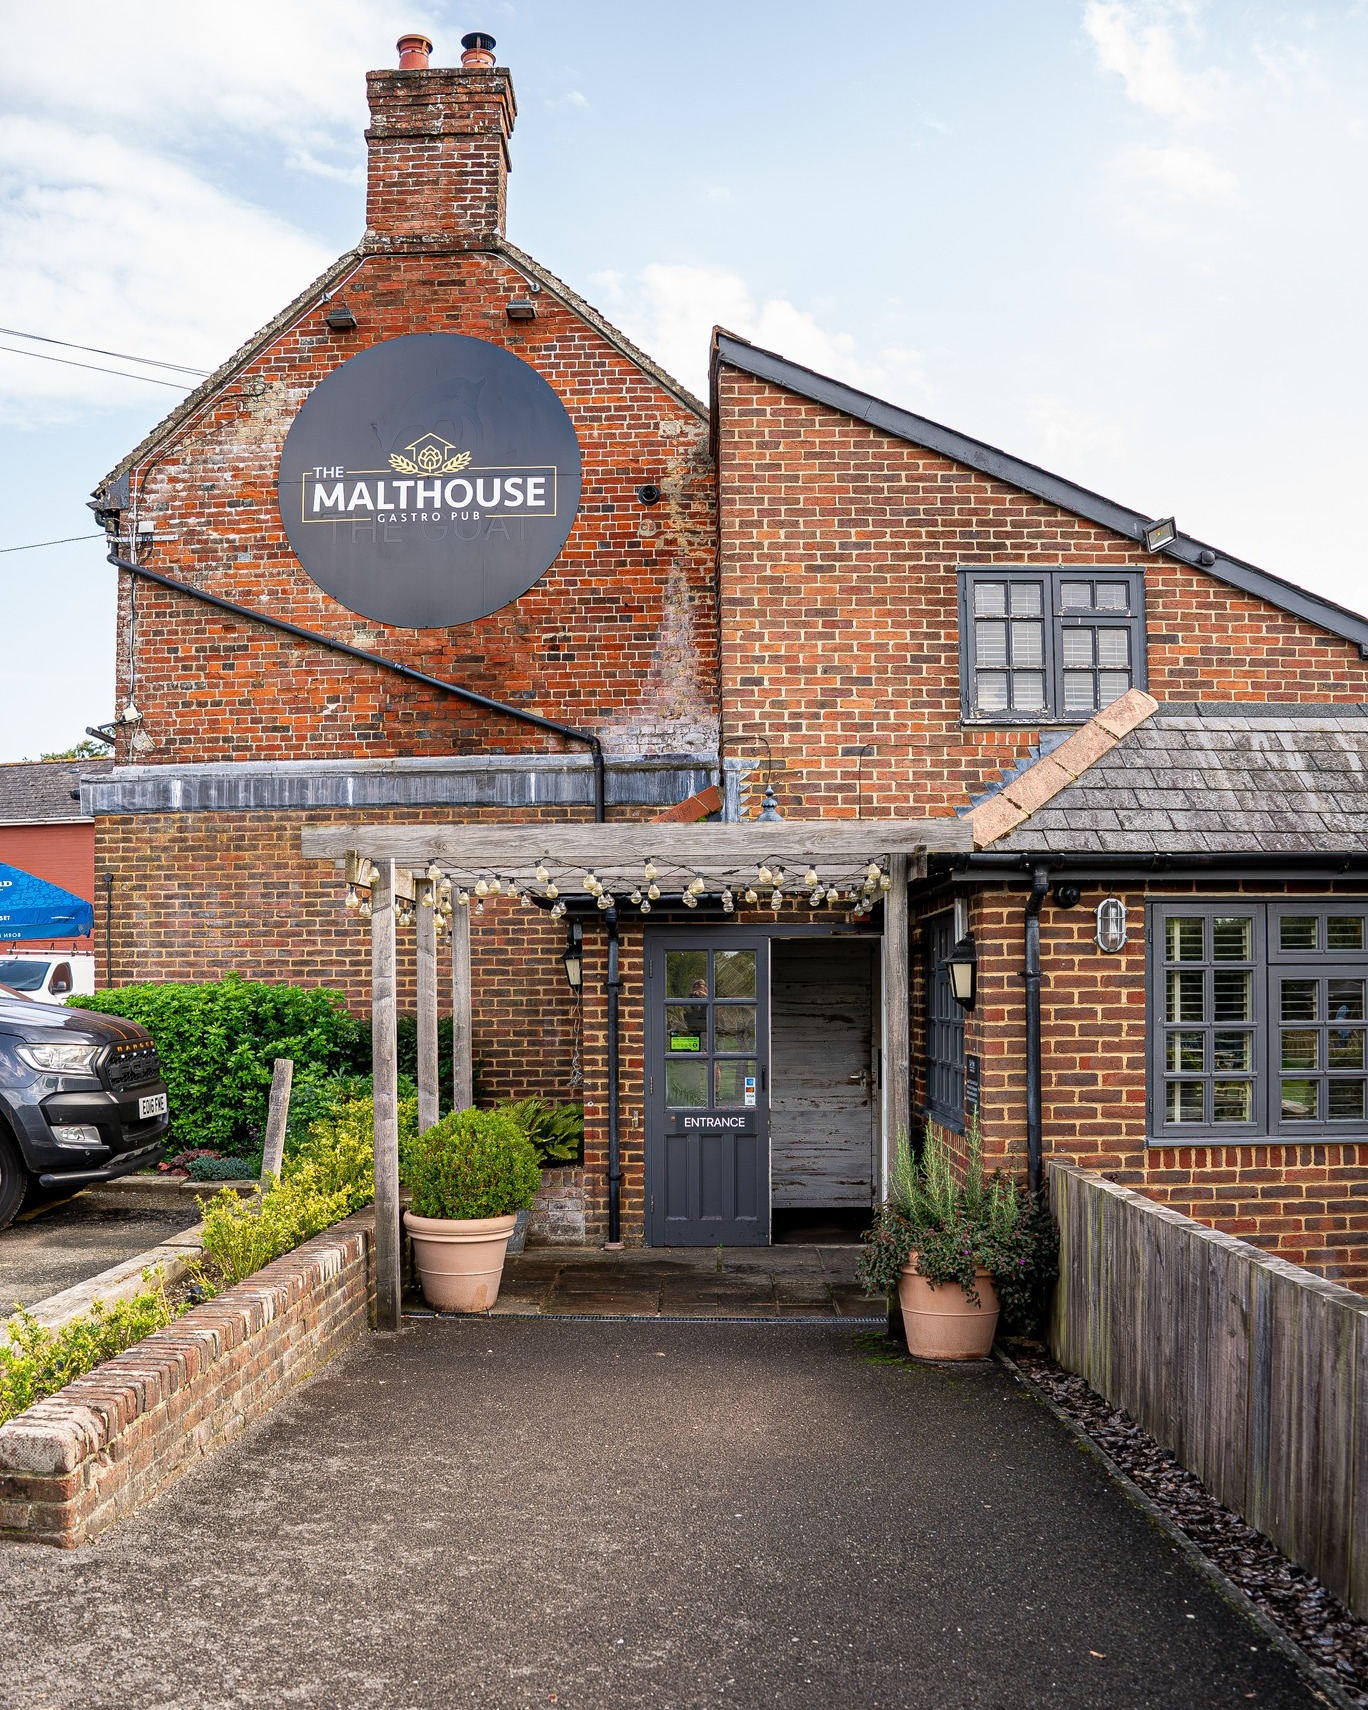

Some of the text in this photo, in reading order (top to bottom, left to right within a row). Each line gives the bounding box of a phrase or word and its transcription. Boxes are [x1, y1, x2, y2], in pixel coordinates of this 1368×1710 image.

[313, 466, 344, 479] THE
[312, 477, 546, 512] MALTHOUSE
[377, 511, 480, 523] GASTRO PUB
[322, 508, 535, 545] THE GOAT
[684, 1117, 746, 1128] ENTRANCE
